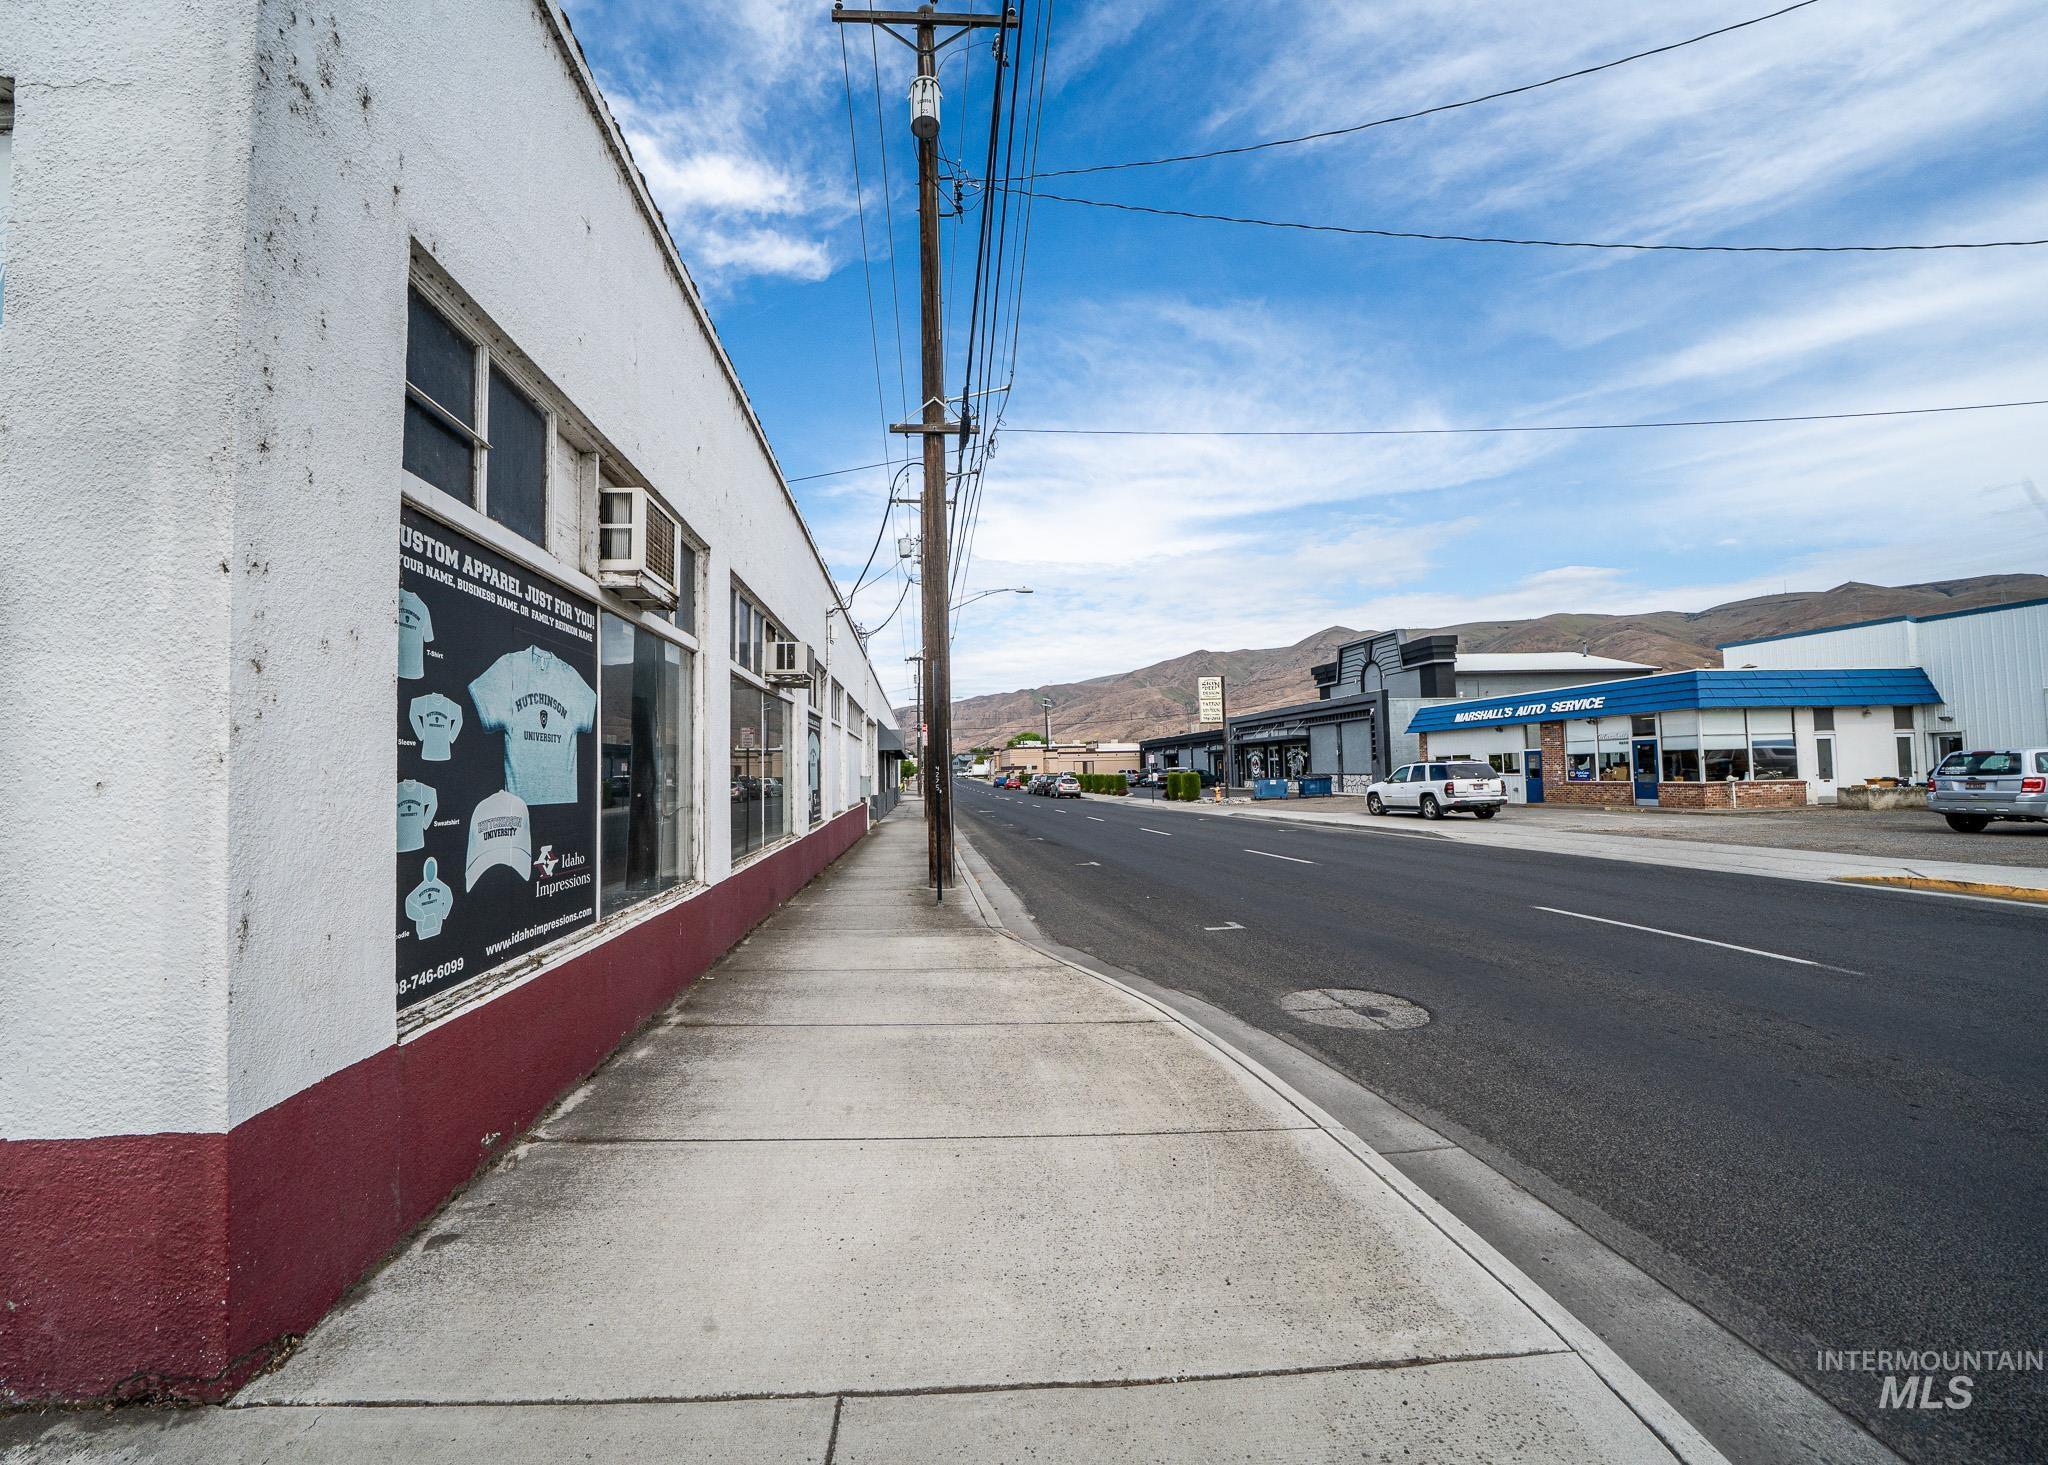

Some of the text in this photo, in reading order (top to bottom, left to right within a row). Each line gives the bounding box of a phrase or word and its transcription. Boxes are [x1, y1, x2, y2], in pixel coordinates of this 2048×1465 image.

[425, 564, 456, 588] NAME,
[457, 577, 496, 604] BUSINESS
[496, 594, 520, 614] NAME,
[520, 605, 529, 617] OR
[531, 609, 555, 627] FAMILY
[554, 619, 578, 637] REUNION
[578, 630, 593, 643] NAME
[462, 554, 523, 598] APPAREL
[525, 584, 553, 611] JUST
[554, 597, 573, 620] FOR
[574, 606, 595, 630] YOU!
[426, 649, 444, 660] T-Shirt
[515, 692, 568, 719] HUTCHINSON
[1454, 696, 1606, 723] MARSHALL'S AUTO SERVICE
[523, 730, 562, 743] UNIVERSITY
[483, 827, 517, 841] UNIVERSITY
[561, 851, 585, 868] Idaho
[535, 872, 591, 898] Impressions
[485, 906, 592, 957] www.idahoimpressions.com
